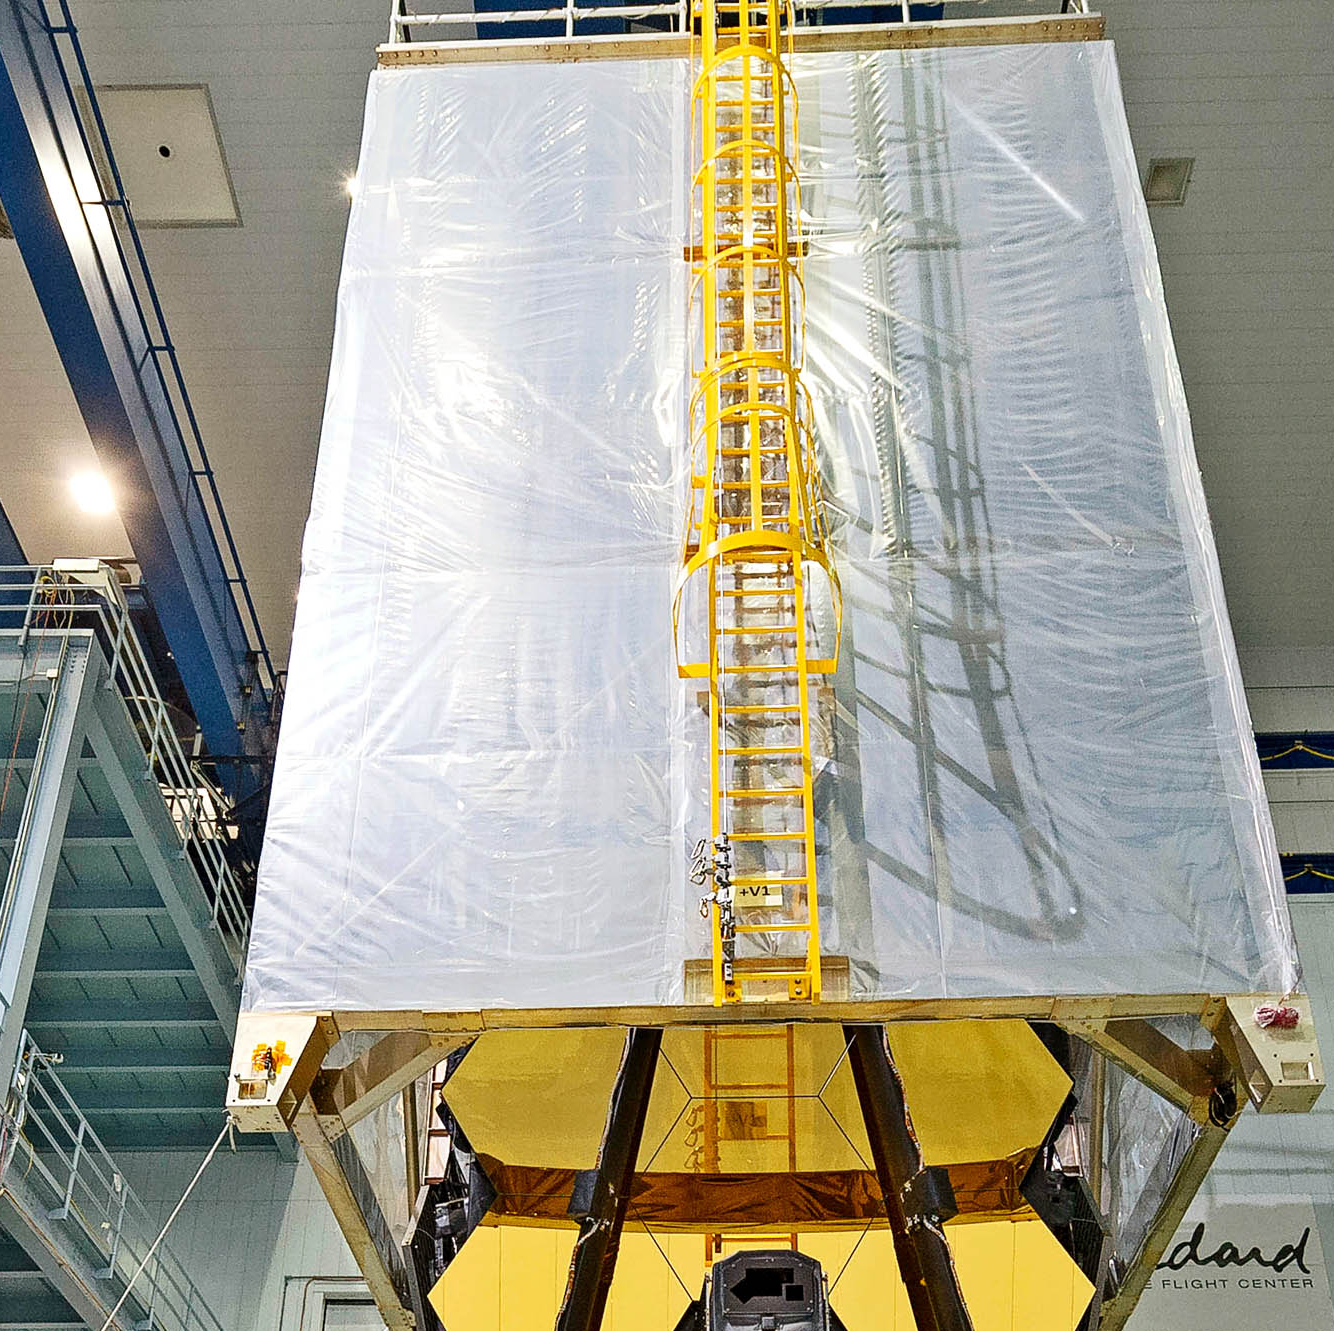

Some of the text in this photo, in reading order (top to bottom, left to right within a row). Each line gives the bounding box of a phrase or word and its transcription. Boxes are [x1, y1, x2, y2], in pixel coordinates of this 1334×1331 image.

[739, 885, 771, 897] +V1
[1156, 1222, 1311, 1274] dard
[1162, 1279, 1228, 1289] FLIGHT
[1238, 1278, 1314, 1289] CENTER
